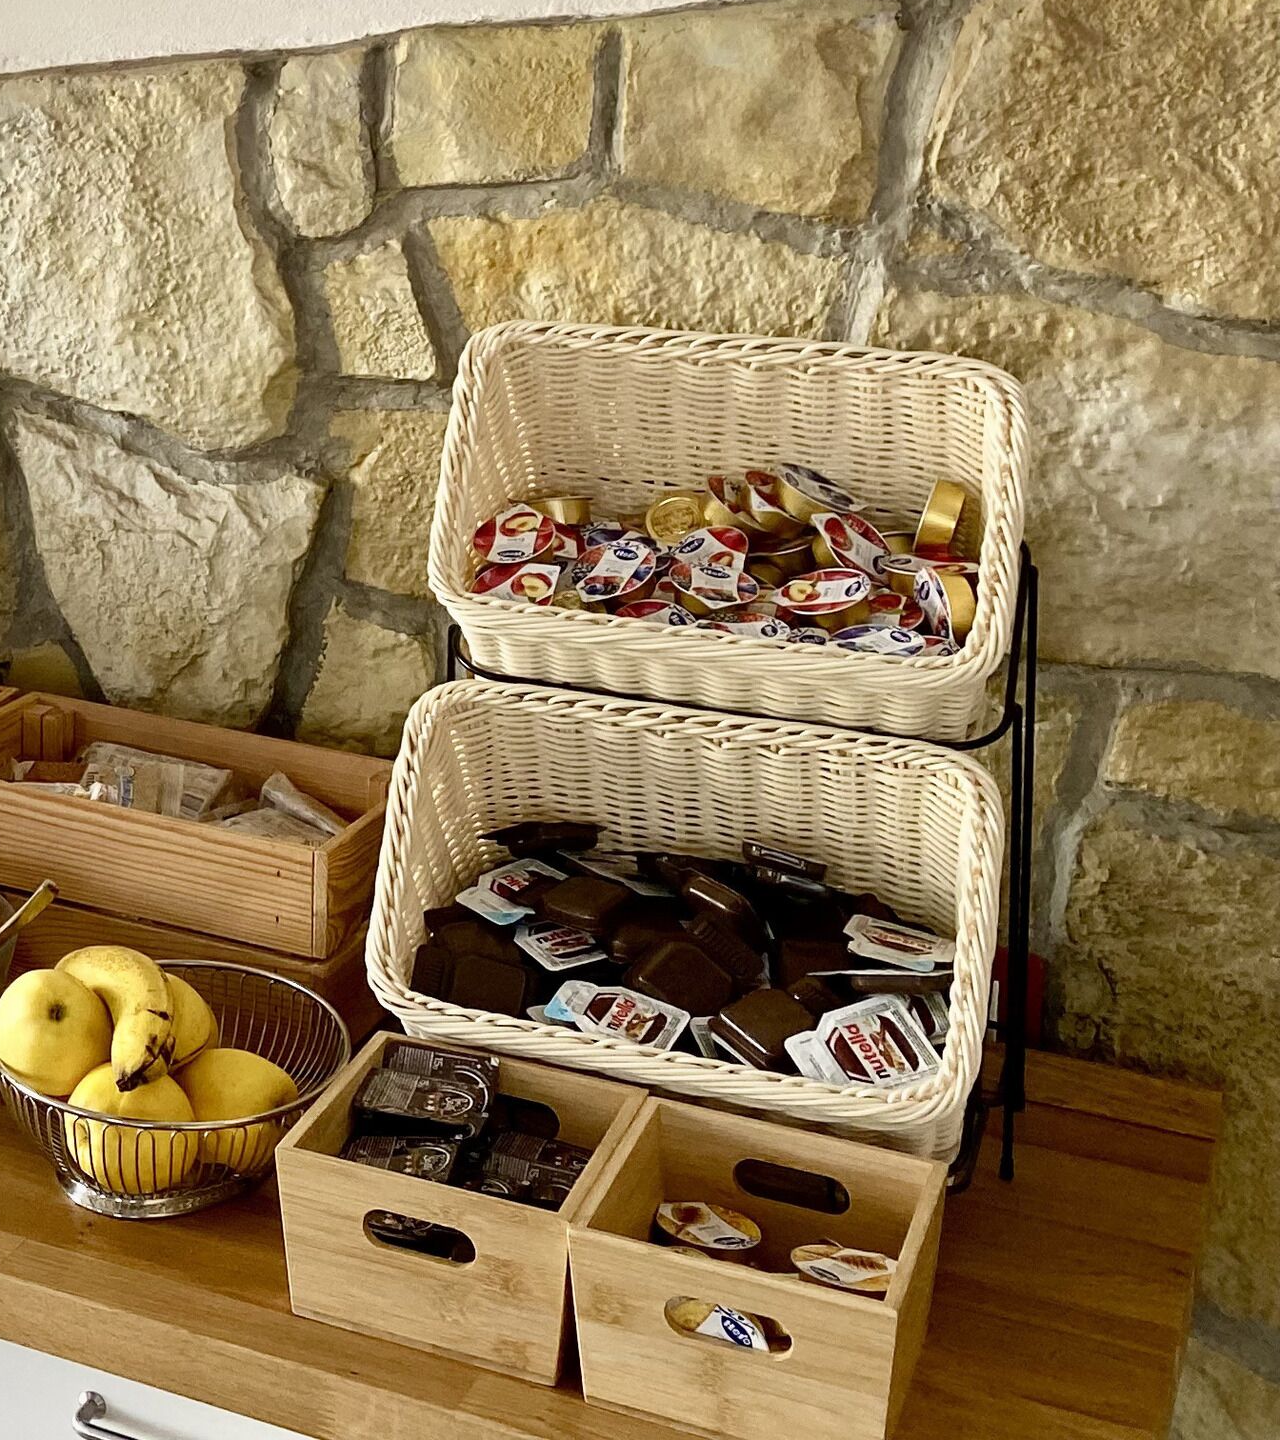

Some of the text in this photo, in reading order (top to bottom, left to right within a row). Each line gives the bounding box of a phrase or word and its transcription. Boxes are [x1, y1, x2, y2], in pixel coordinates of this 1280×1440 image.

[606, 996, 637, 1031] nutella
[842, 1023, 892, 1080] nutella
[722, 1316, 752, 1348] Hero
